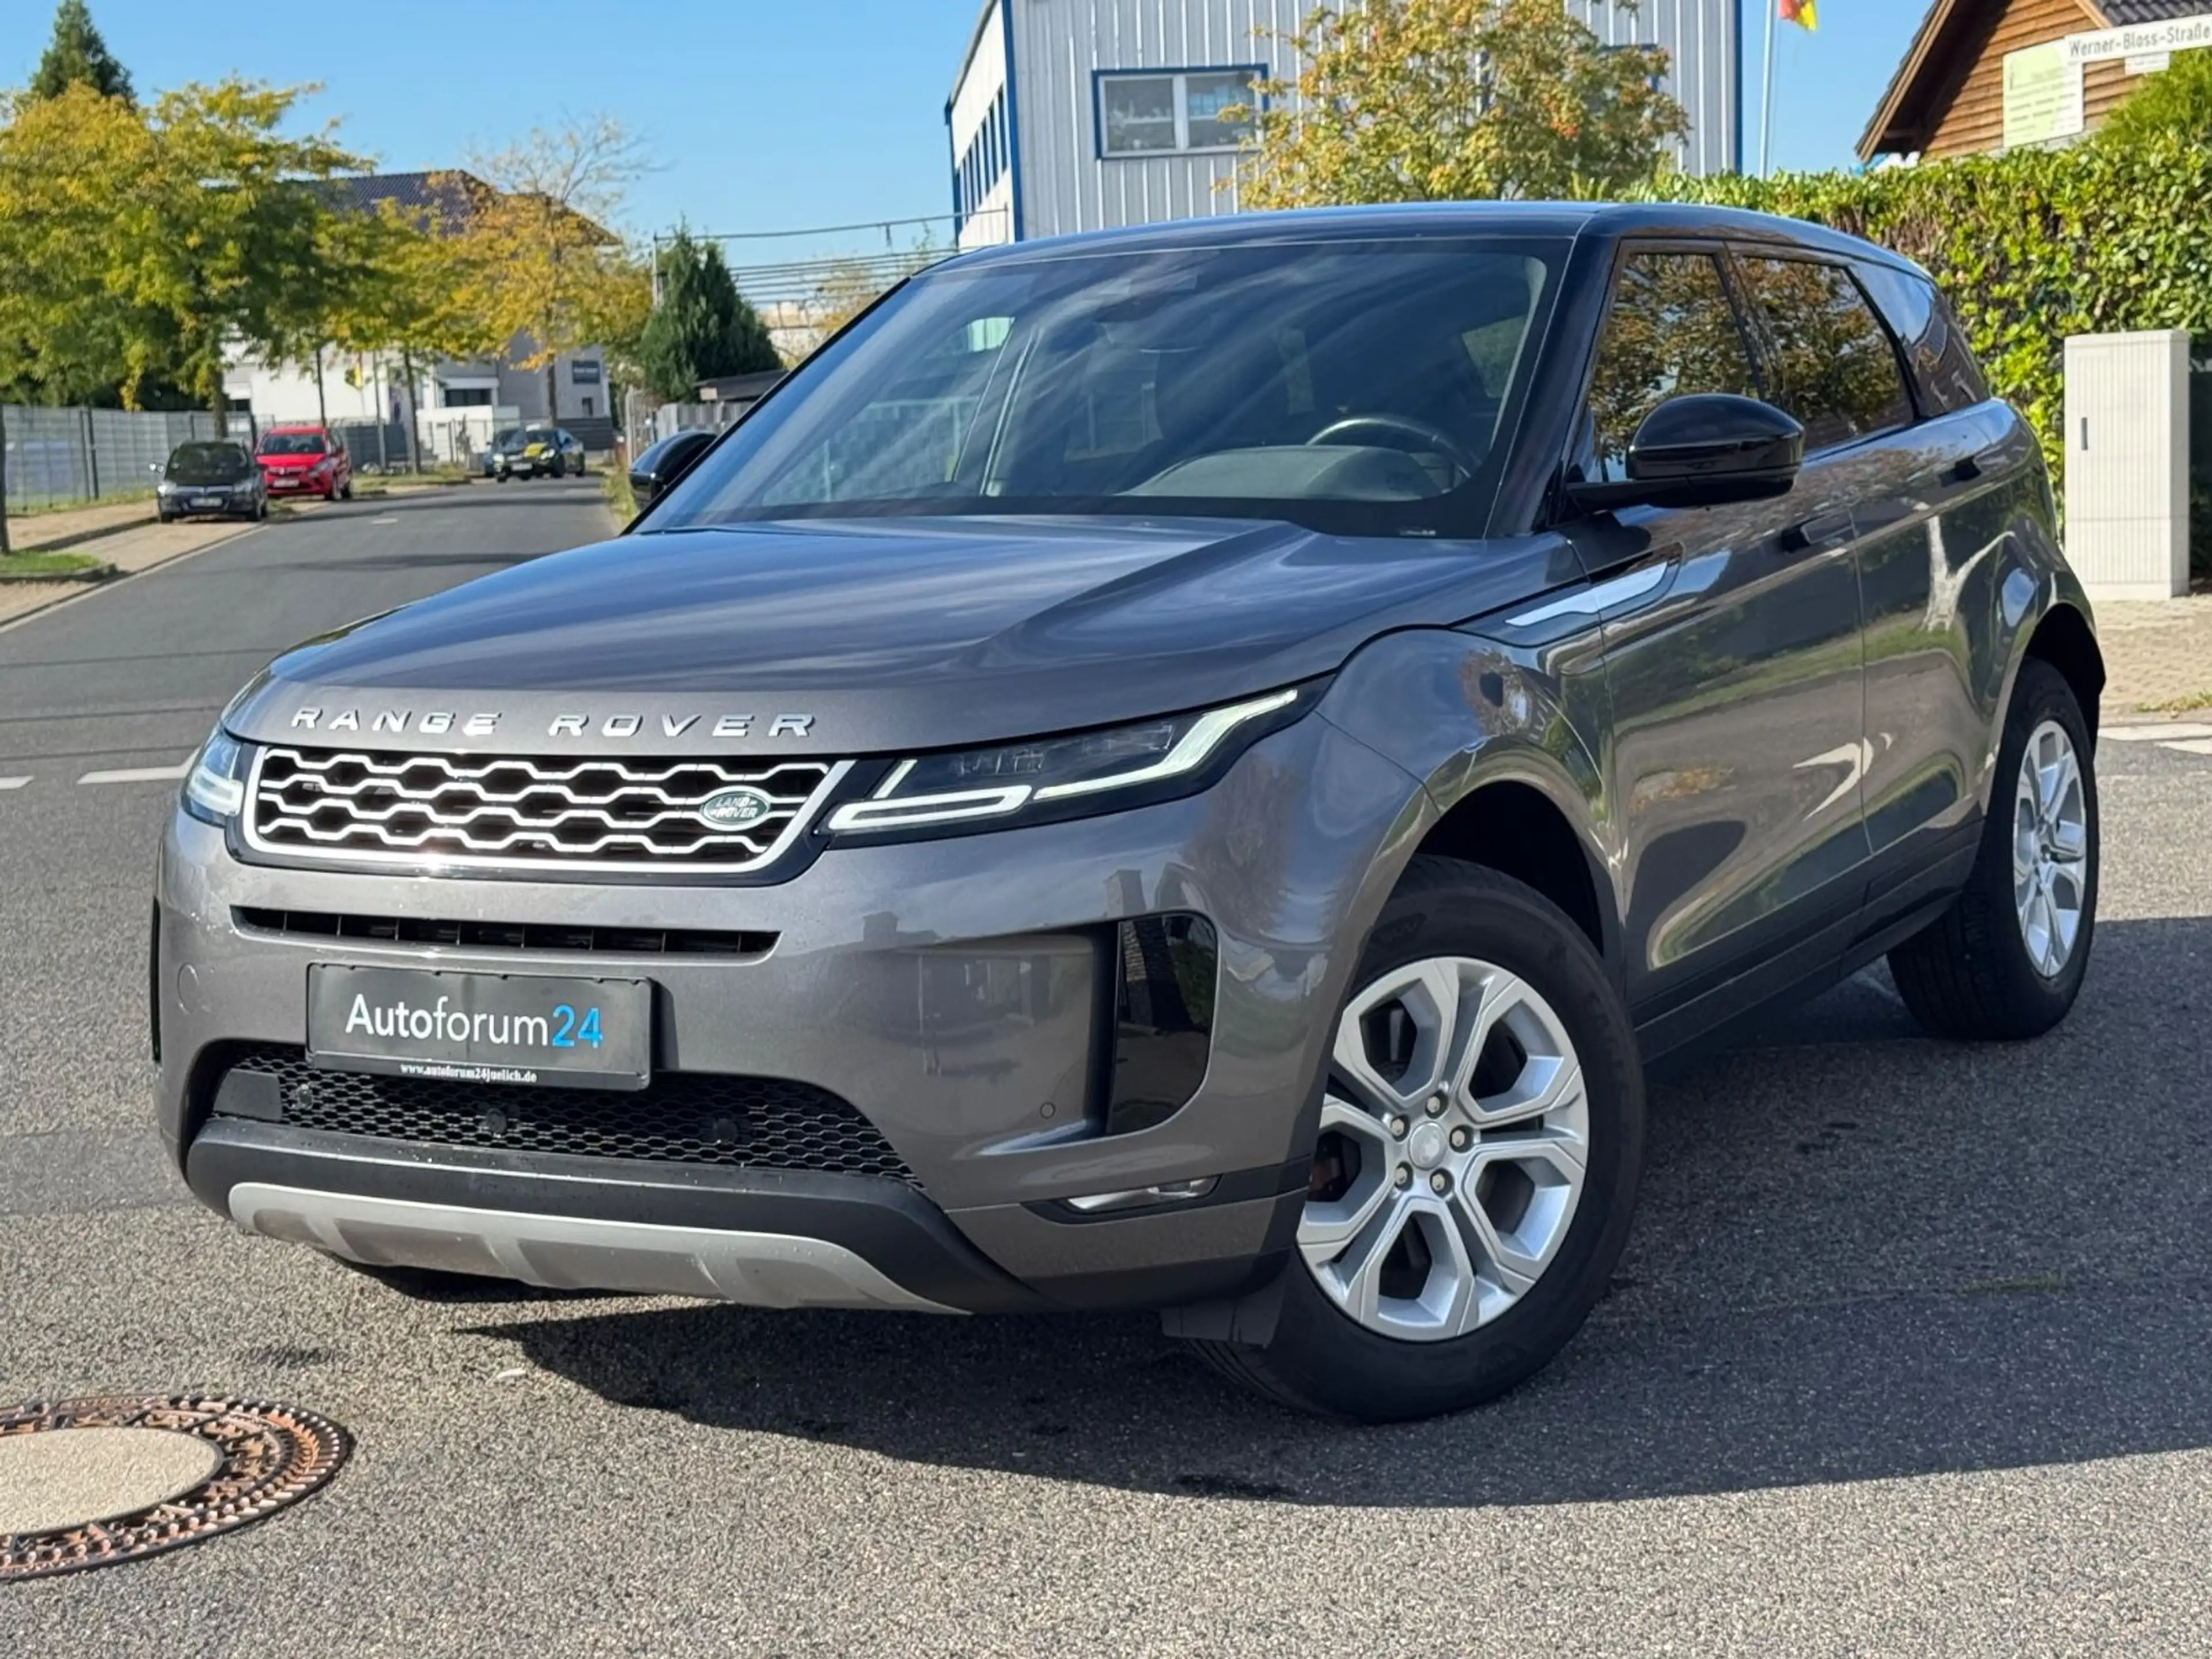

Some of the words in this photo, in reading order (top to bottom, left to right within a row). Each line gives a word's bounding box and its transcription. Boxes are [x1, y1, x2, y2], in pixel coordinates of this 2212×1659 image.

[291, 707, 502, 737] RANGE
[548, 713, 816, 737] ROVER
[346, 994, 603, 1048] Autoforum24
[400, 1063, 537, 1083] www.autoforum24juelich.de
